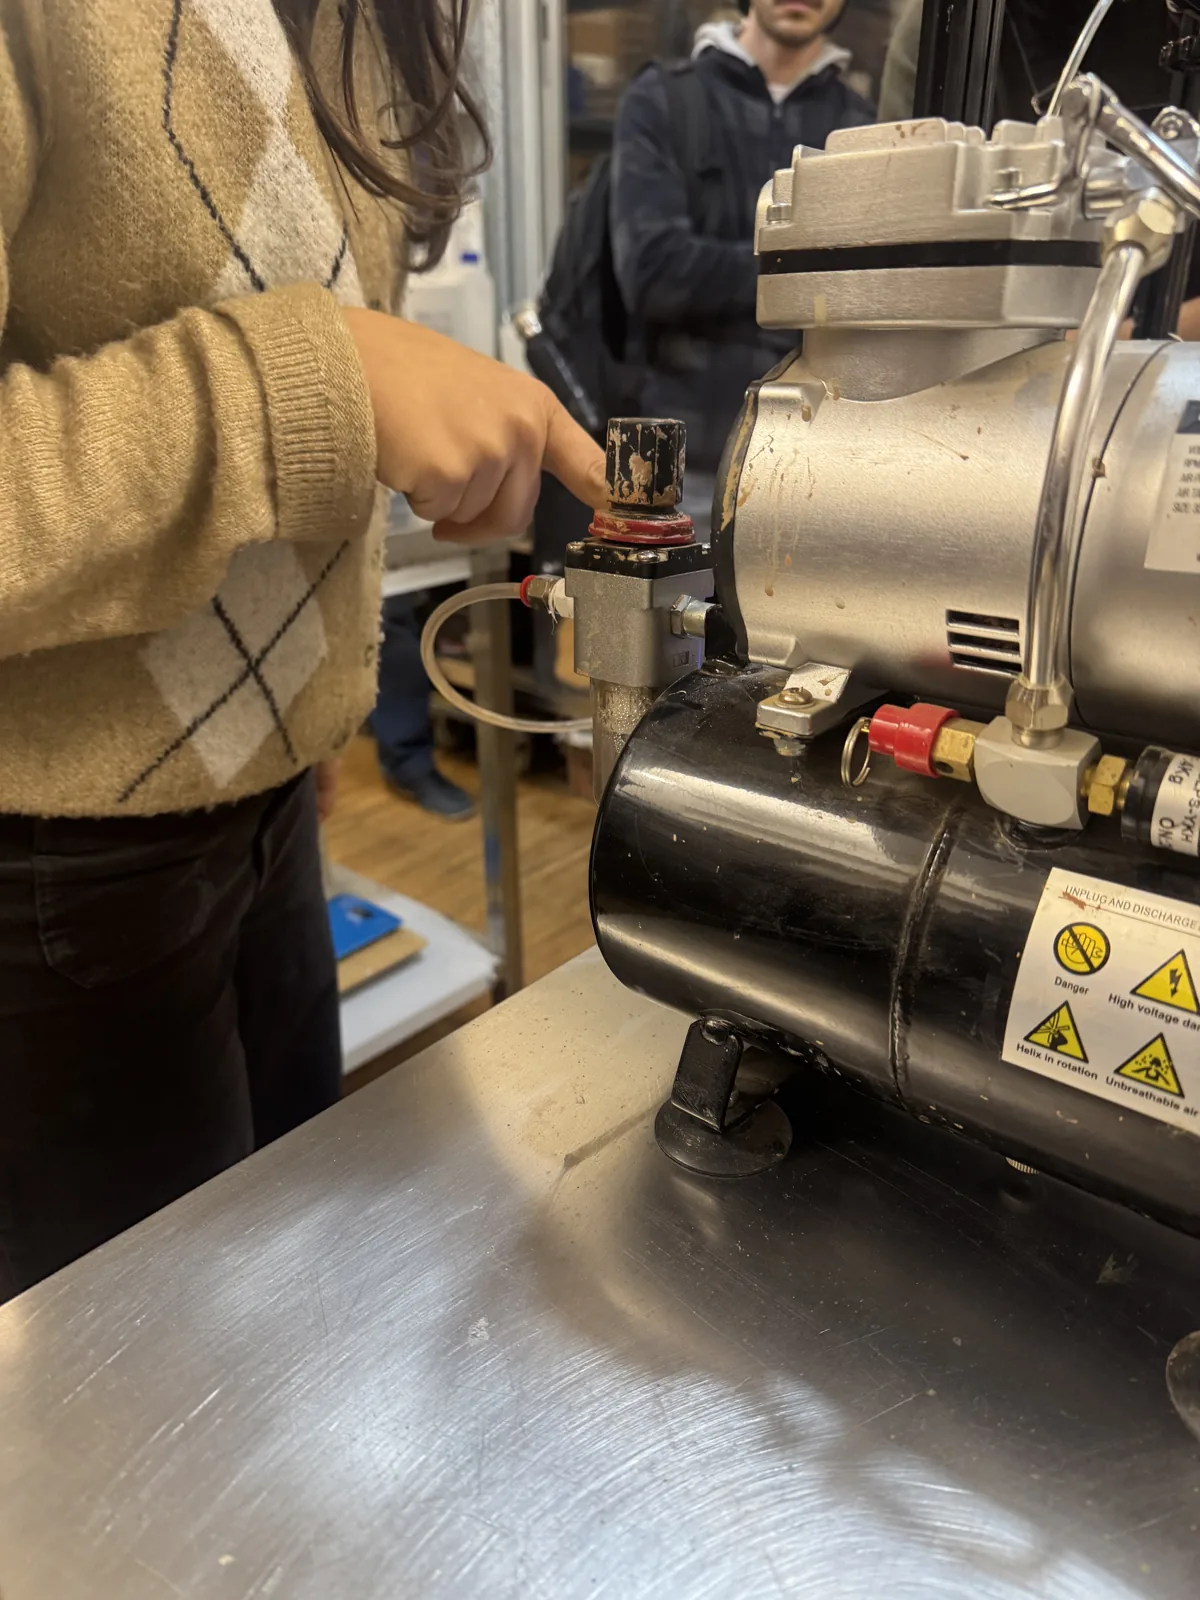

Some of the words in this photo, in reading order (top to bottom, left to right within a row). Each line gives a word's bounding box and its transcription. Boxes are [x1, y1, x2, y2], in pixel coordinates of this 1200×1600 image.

[1065, 884, 1108, 904] UNPLUG
[1108, 898, 1131, 911] AND
[1132, 904, 1197, 930] DISCHARGE
[1054, 975, 1090, 995] Danger
[1108, 993, 1134, 1010] High
[1137, 1004, 1180, 1024] voltage
[1016, 1043, 1042, 1060] Helix
[1044, 1053, 1054, 1064] in
[1056, 1058, 1098, 1081] rotation
[1105, 1075, 1180, 1111] Unbreathable
[1182, 1104, 1199, 1118] air
